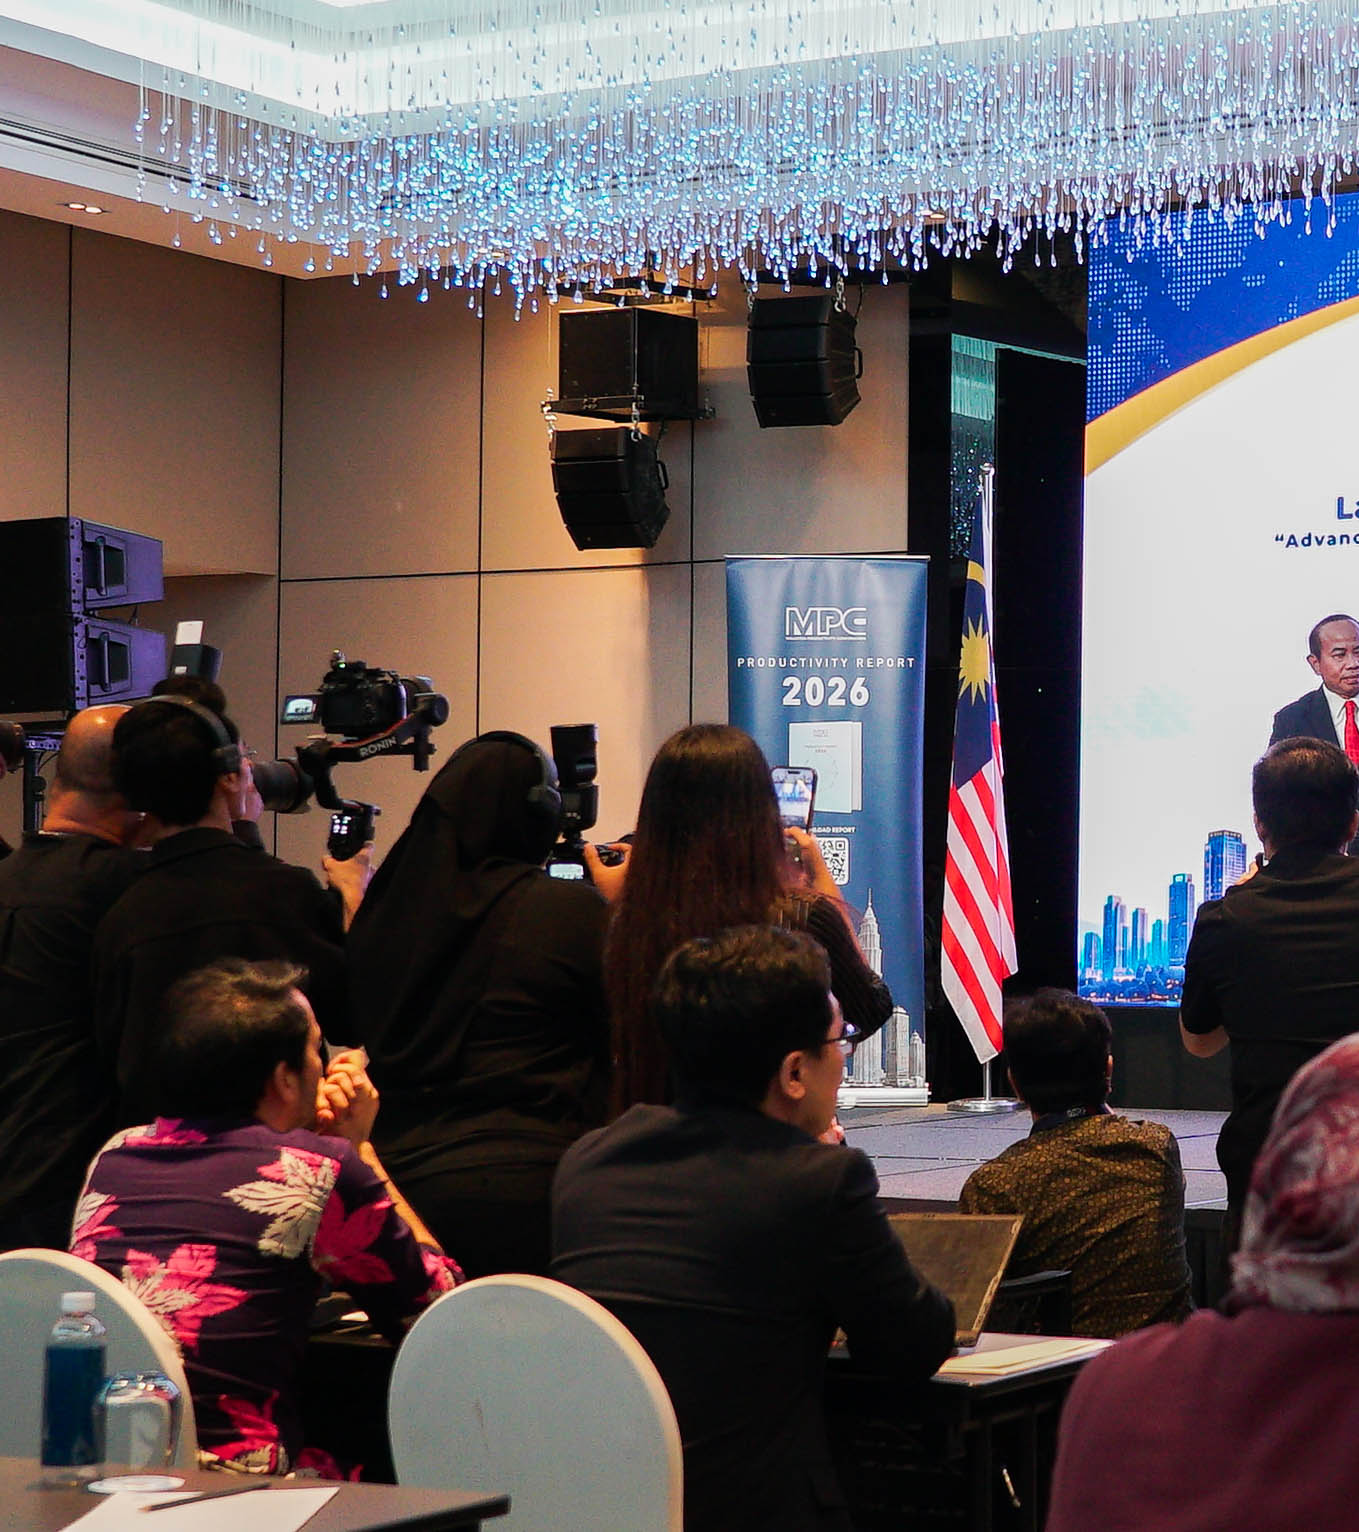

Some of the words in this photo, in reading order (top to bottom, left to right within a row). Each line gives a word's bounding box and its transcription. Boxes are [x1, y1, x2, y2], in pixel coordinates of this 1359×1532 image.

[785, 606, 867, 636] MPC
[737, 656, 849, 669] PRODUCTIVITY
[855, 656, 916, 669] REPORT
[782, 676, 870, 706] 2026
